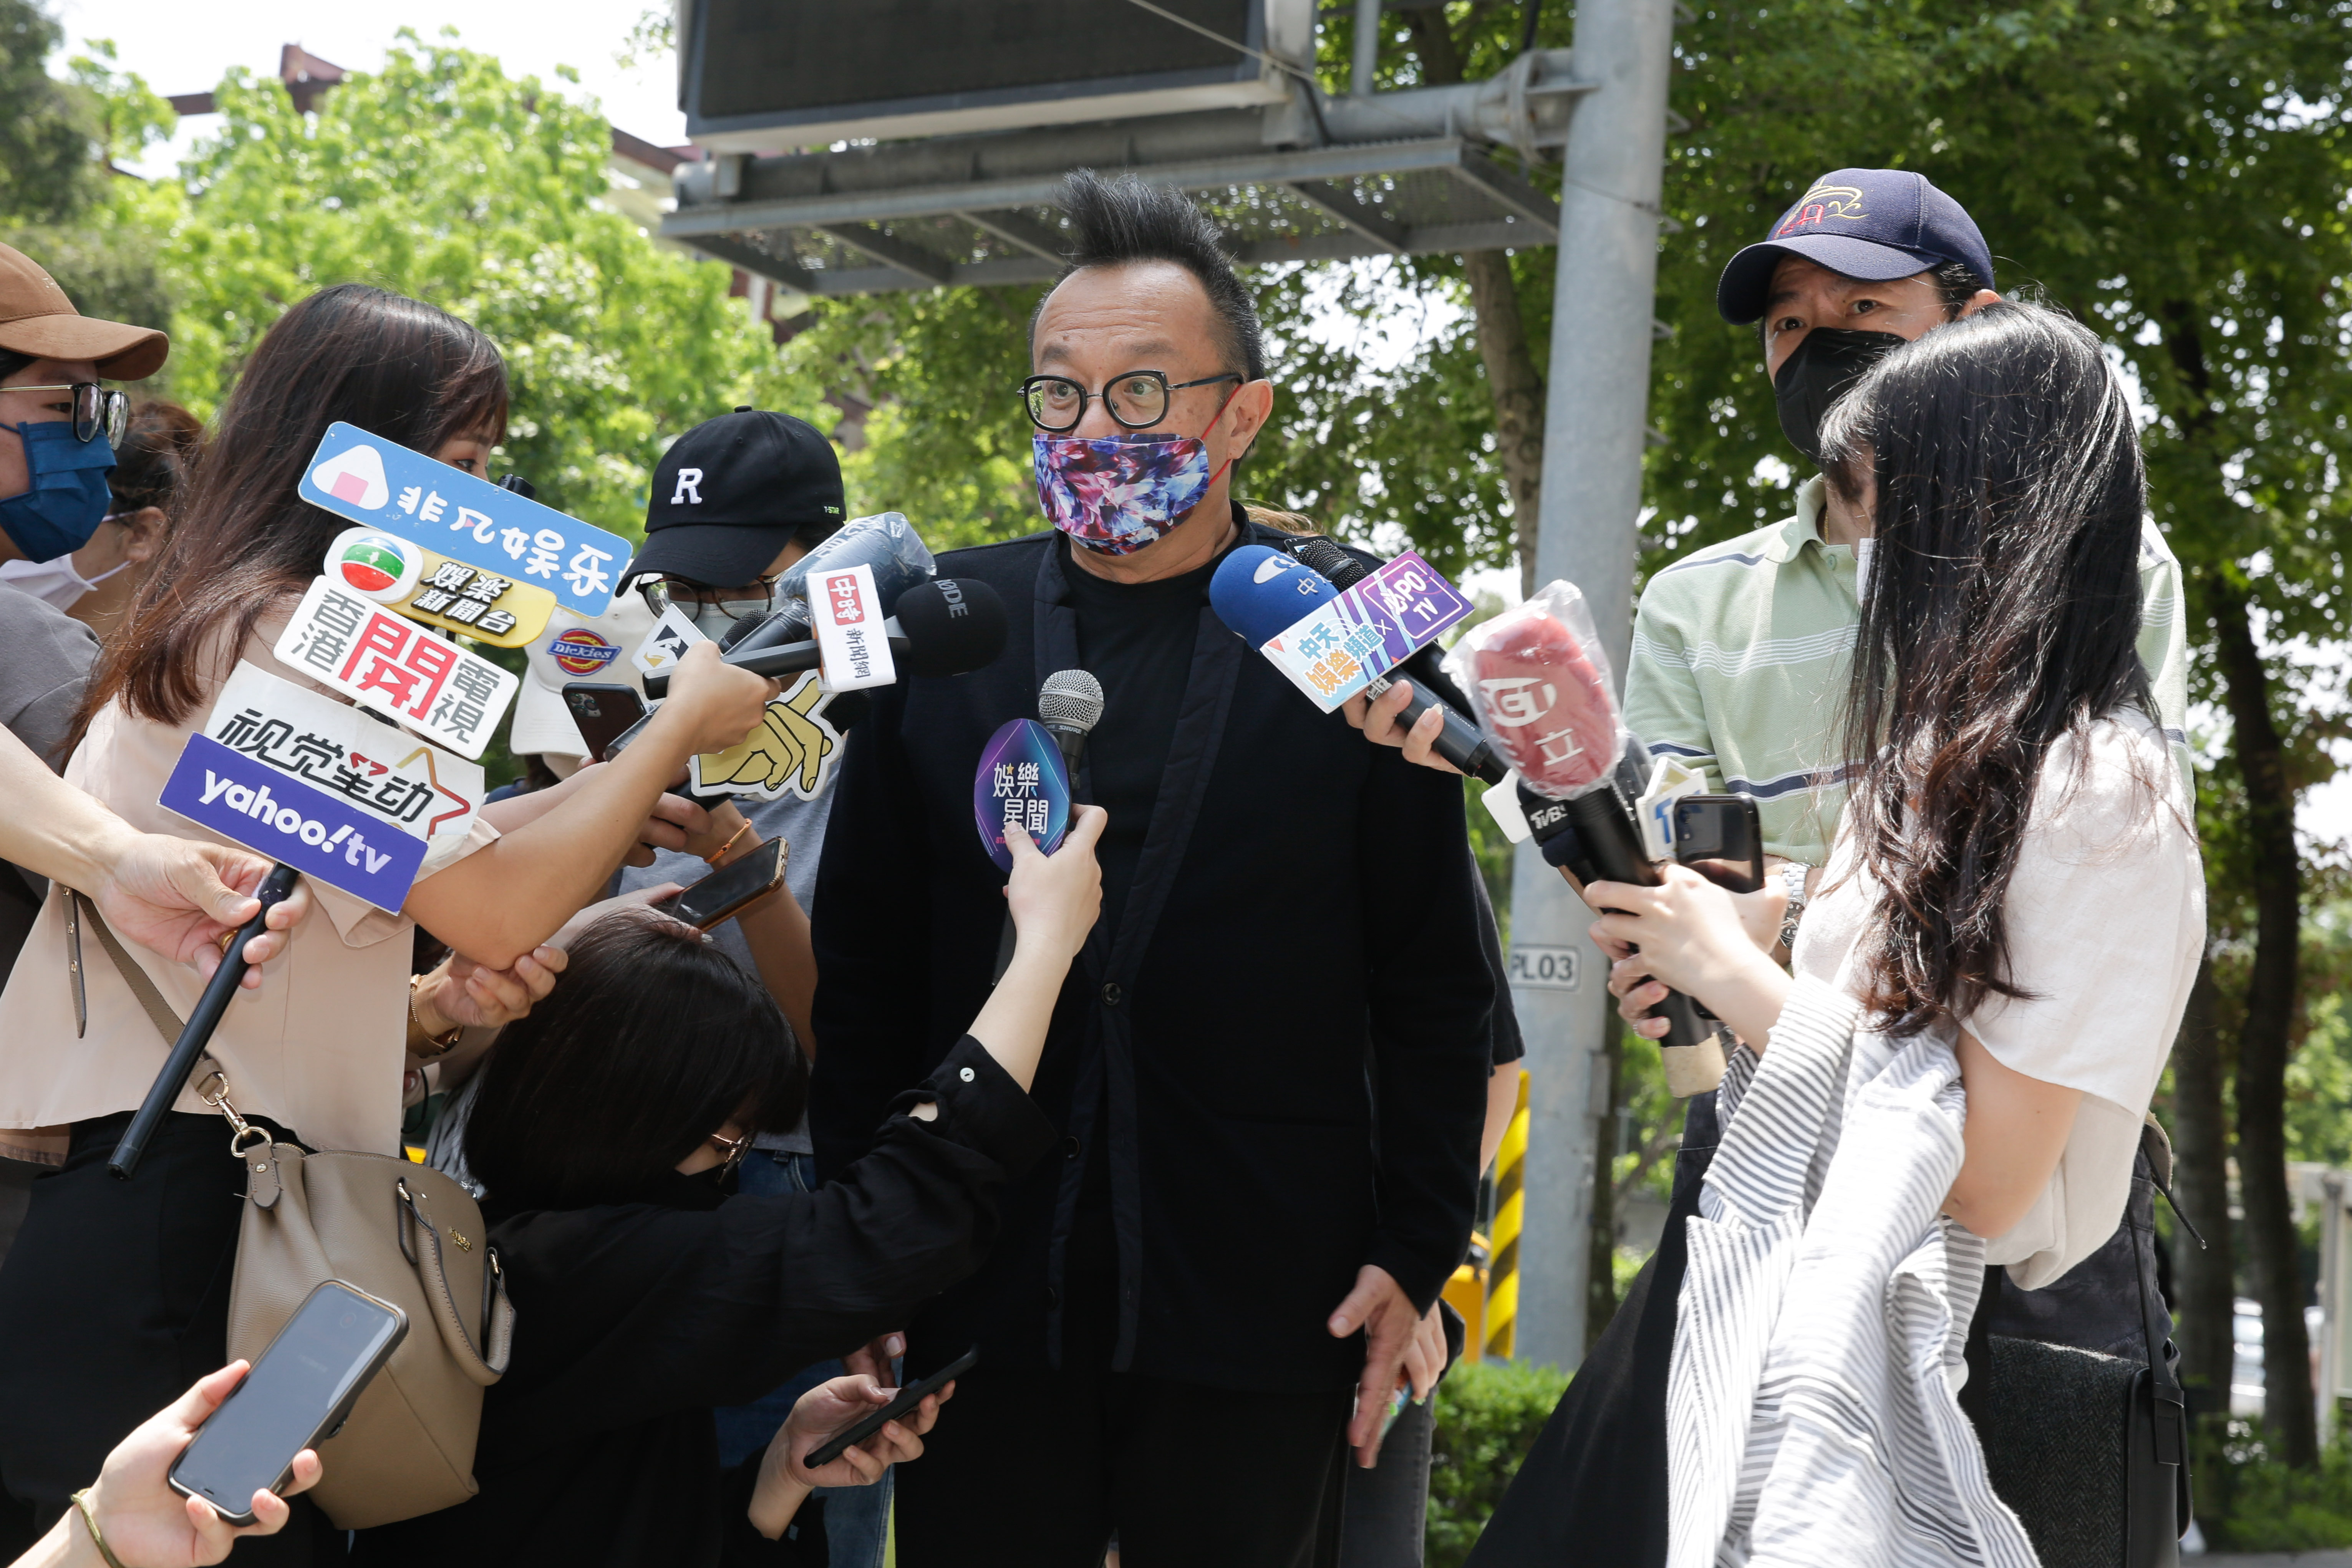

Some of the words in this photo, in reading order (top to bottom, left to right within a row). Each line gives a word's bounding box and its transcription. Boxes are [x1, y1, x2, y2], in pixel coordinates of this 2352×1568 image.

[671, 468, 703, 504] R
[397, 486, 613, 597] 非凡娱乐
[411, 588, 516, 636] 新聞台
[1413, 597, 1439, 622] TV
[1296, 621, 1341, 660] 中天
[1058, 725, 1082, 734] SHURE
[216, 708, 435, 823] 视觉星动
[992, 762, 1040, 798] 娛樂
[1001, 799, 1049, 835] 星聞
